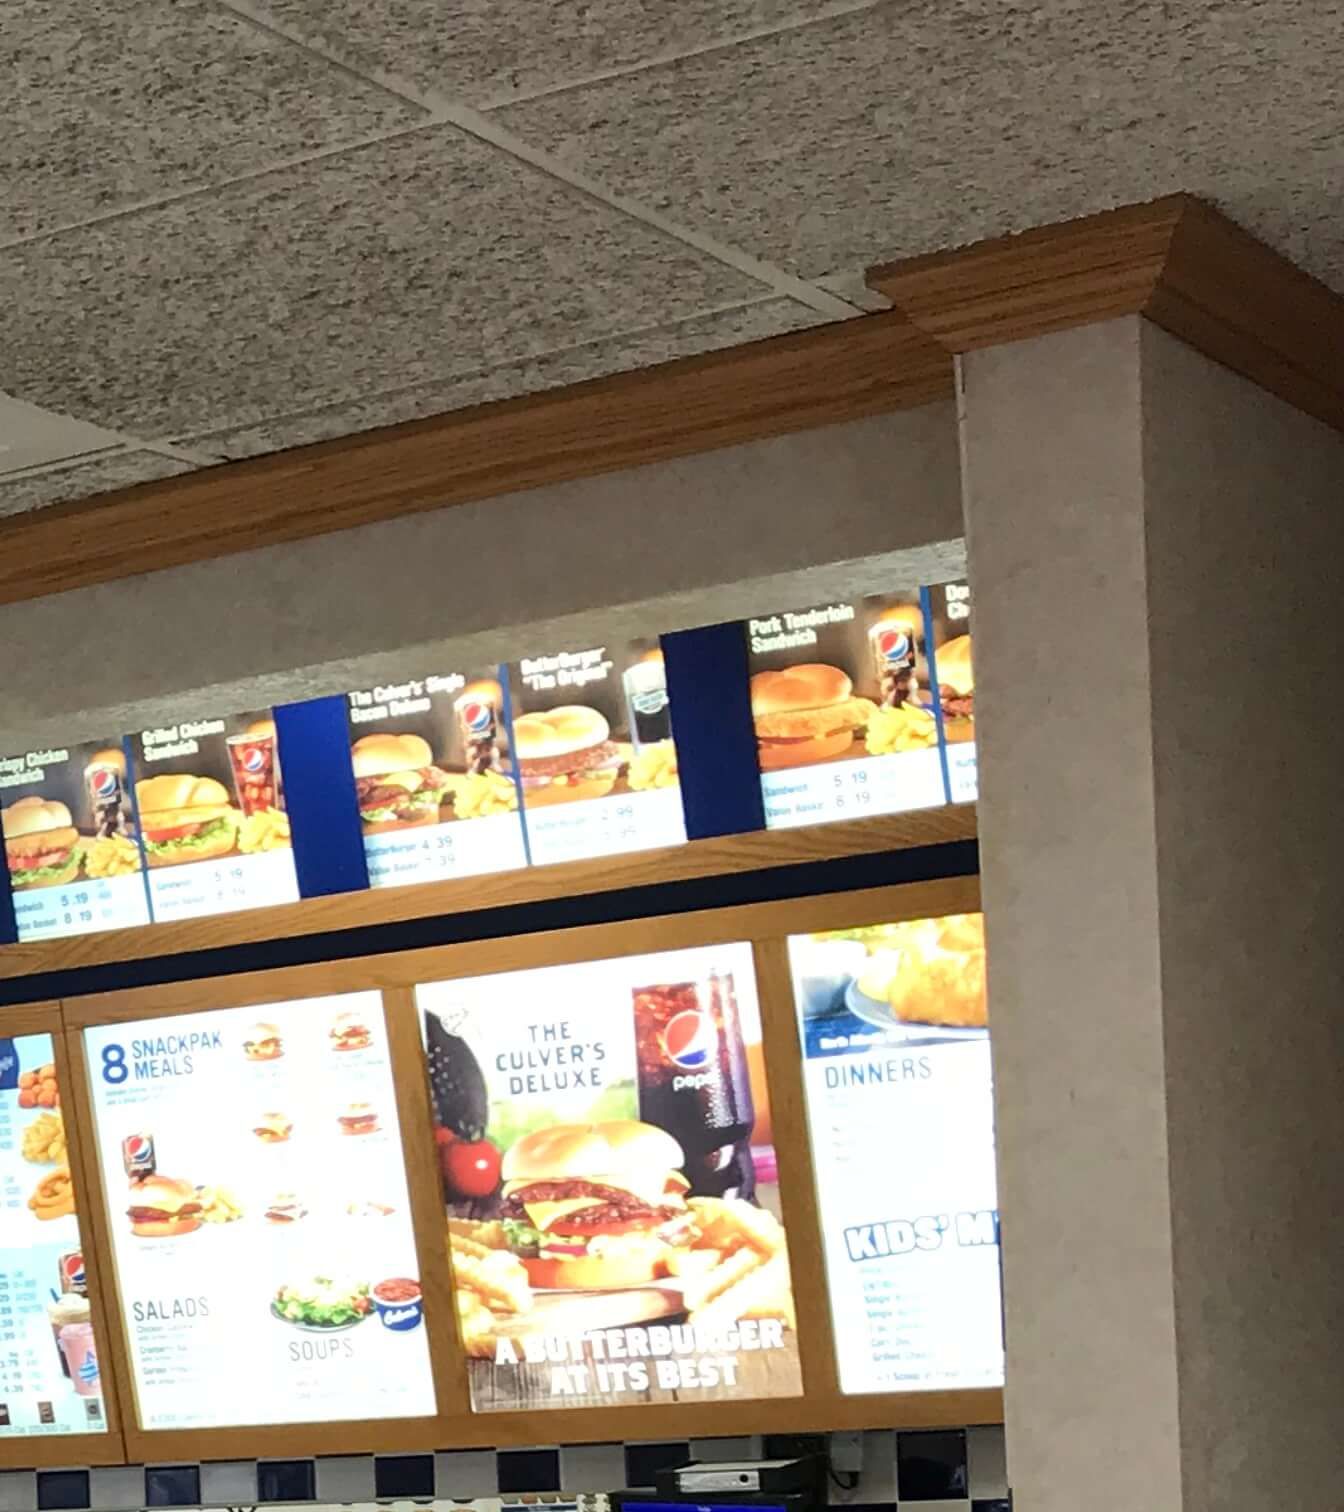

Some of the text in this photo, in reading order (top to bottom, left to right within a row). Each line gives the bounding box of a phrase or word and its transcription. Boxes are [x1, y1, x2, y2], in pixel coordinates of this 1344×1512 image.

[749, 604, 855, 636] Pork Tenderloin
[752, 629, 817, 654] Sandwich
[520, 648, 606, 677] ButterBurger
[348, 673, 465, 707] The Culver's Single
[349, 697, 431, 724] Bacon Deluxe
[141, 720, 225, 747] Grilled Chicken
[26, 749, 68, 767] Chicken
[144, 739, 199, 762] Sandwich
[834, 771, 867, 787] 519
[61, 892, 88, 908] 5.19
[64, 911, 92, 924] 819
[527, 1021, 571, 1044] THE
[102, 1031, 223, 1085] 8 SNACKPAK
[134, 1056, 194, 1080] MEALS
[495, 1042, 606, 1072] CULVER'S
[509, 1068, 603, 1095] DELUXE
[672, 1071, 721, 1091] peps
[825, 1056, 932, 1089] DINNERS
[843, 1214, 950, 1262] KIDS'
[132, 1297, 210, 1322] SALADS
[288, 1338, 354, 1362] SOUPS
[495, 1318, 785, 1366] A BUTTERBURGER
[551, 1357, 738, 1395] AT ITS BEST
